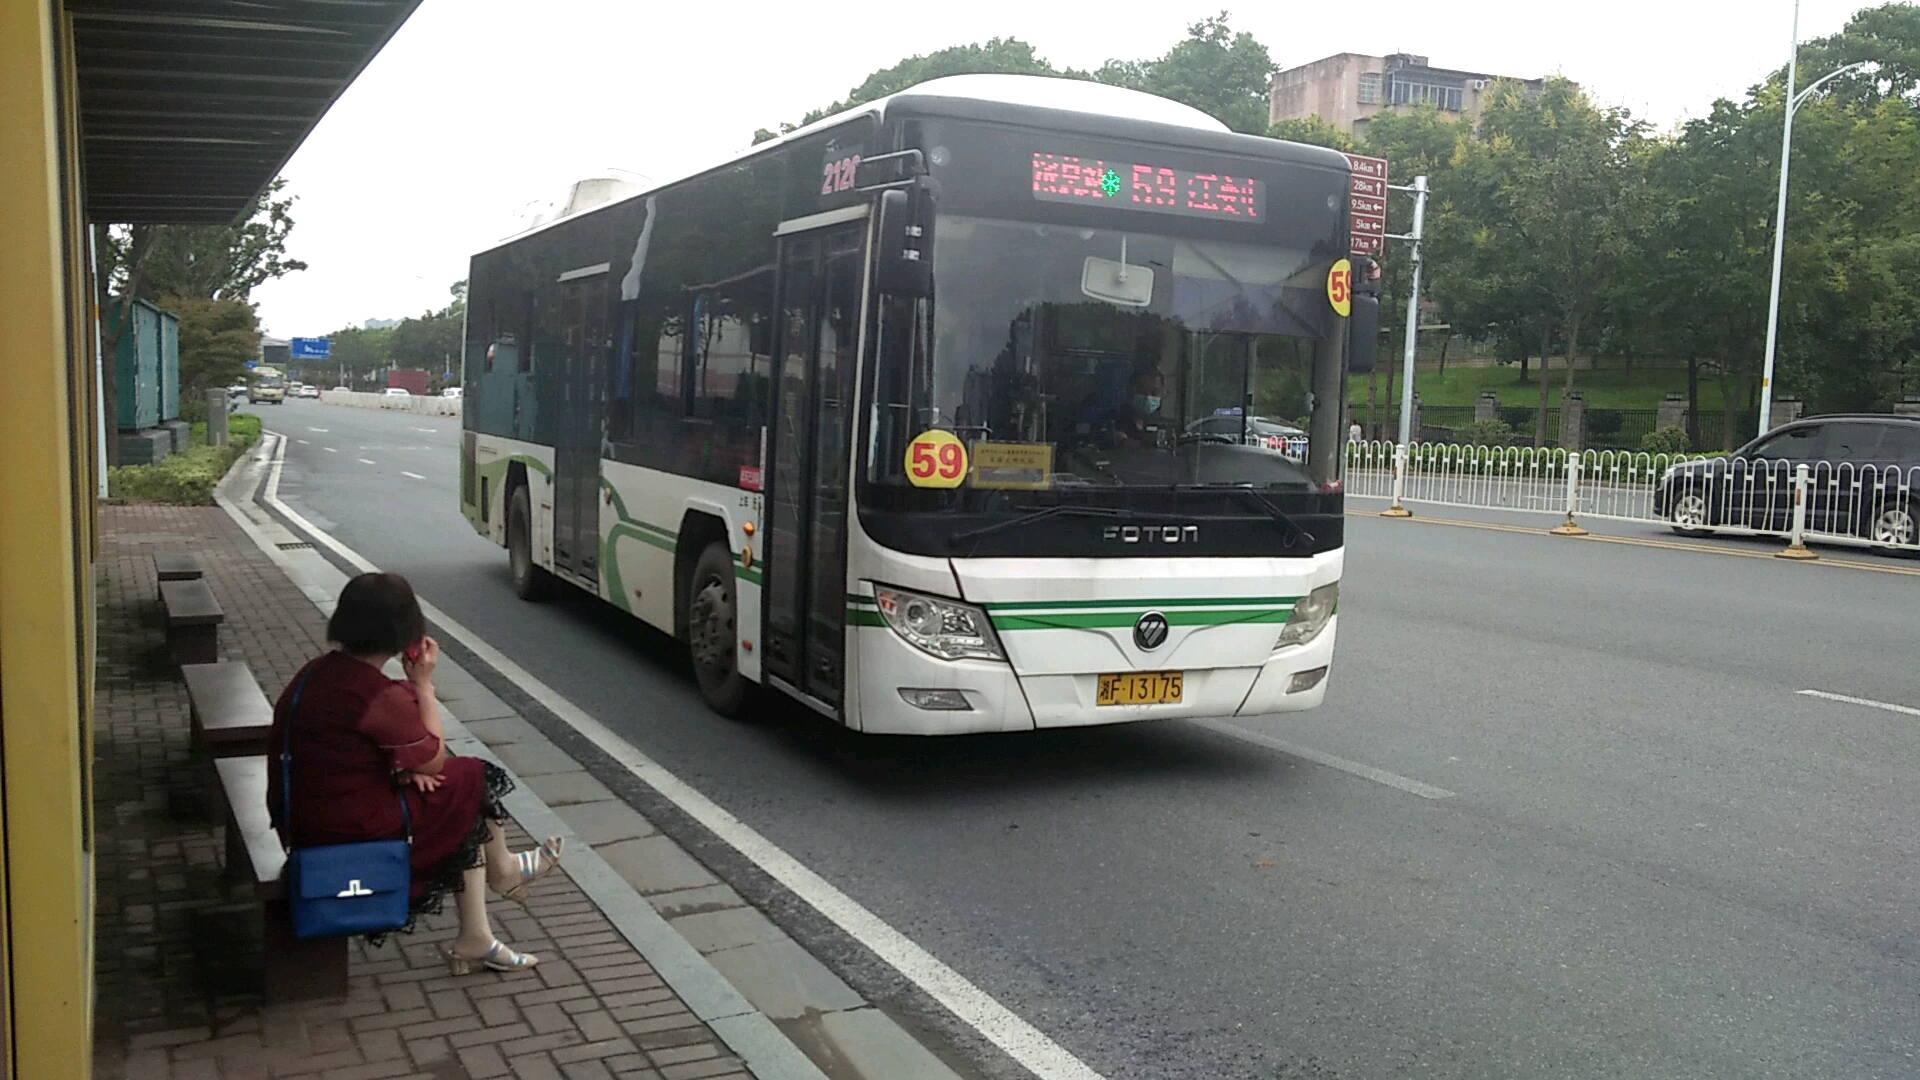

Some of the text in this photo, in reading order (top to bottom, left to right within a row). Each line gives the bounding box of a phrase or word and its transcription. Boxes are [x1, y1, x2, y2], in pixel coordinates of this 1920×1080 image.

[1353, 160, 1374, 174] 8.4km
[1353, 180, 1373, 192] 28km
[1351, 199, 1372, 211] 9.5km
[1355, 219, 1371, 230] 5km
[912, 442, 963, 479] 59
[1103, 526, 1198, 543] FOTON
